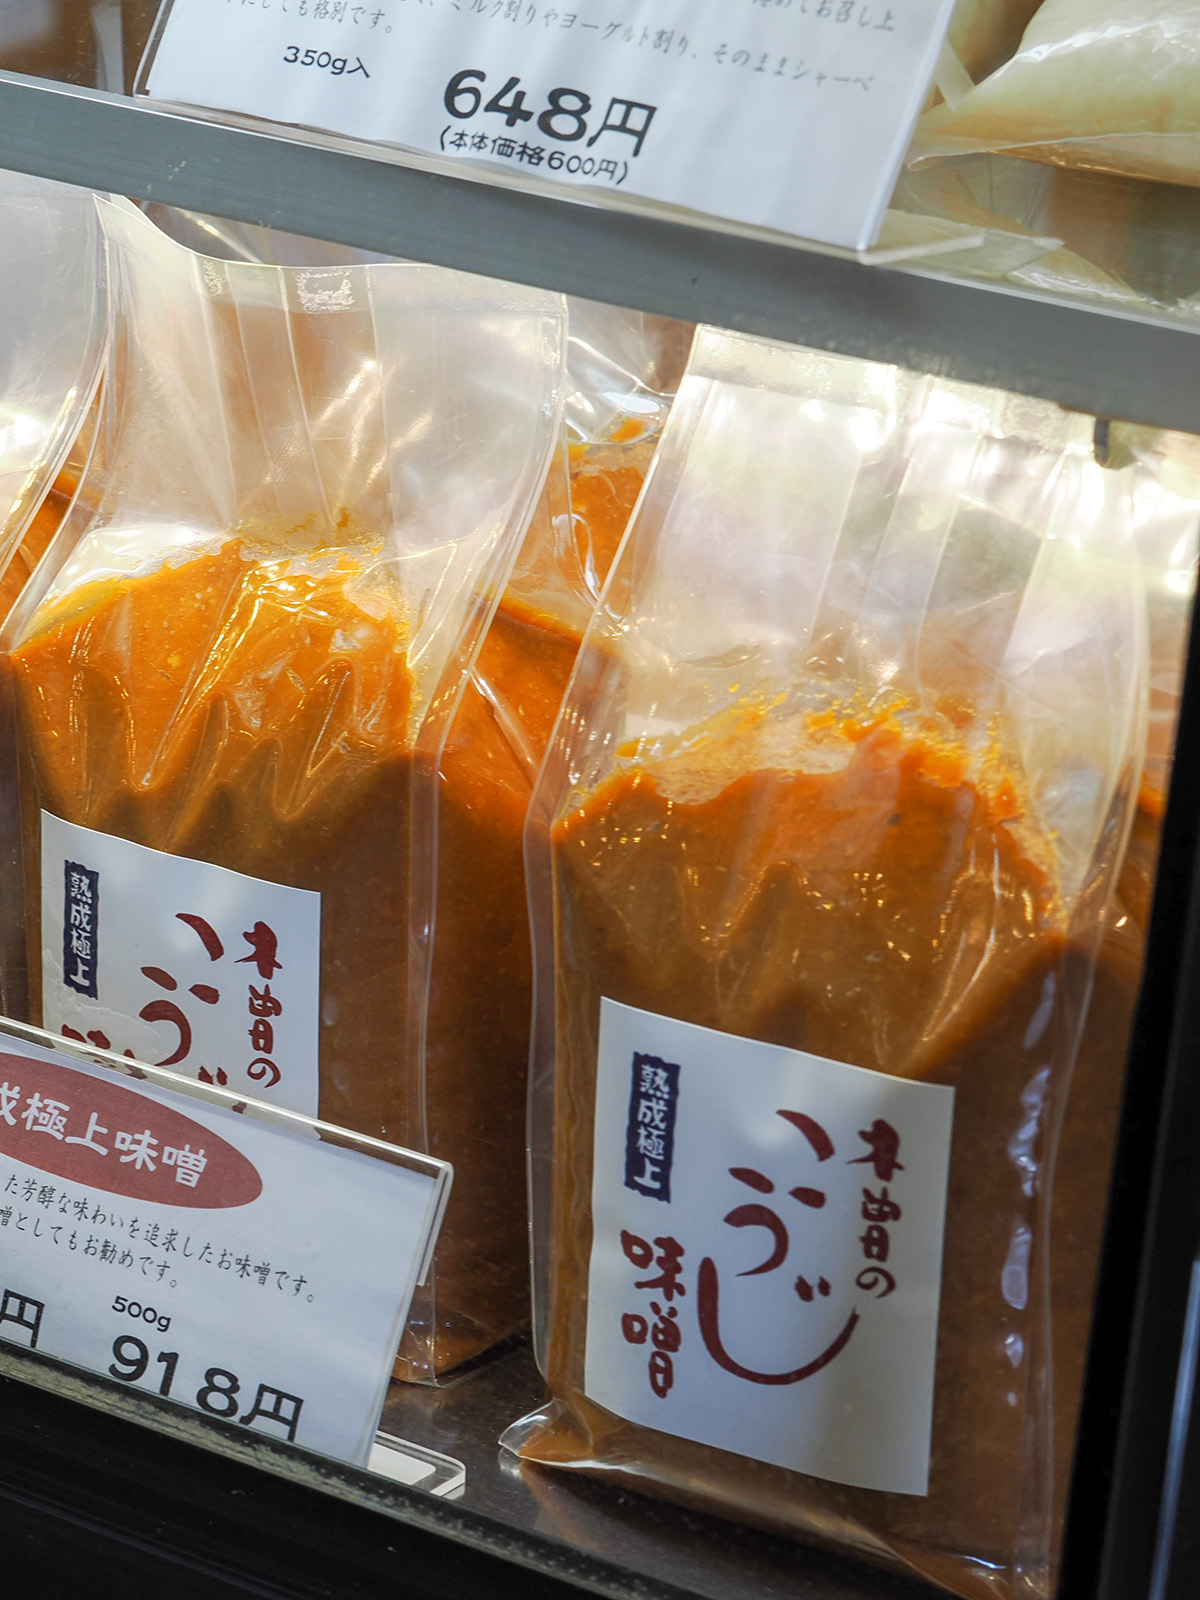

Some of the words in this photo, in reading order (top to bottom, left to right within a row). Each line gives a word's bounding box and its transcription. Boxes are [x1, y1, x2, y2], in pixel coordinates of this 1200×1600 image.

[283, 46, 371, 80] 350g入
[440, 125, 628, 185] (本体価格600円)
[443, 69, 657, 158] 648円
[69, 870, 93, 988] 熟成極上
[633, 1063, 672, 1190] 熟成極上
[111, 1295, 172, 1334] 500g
[620, 1229, 687, 1399] 味噌
[108, 1334, 305, 1443] 918円
